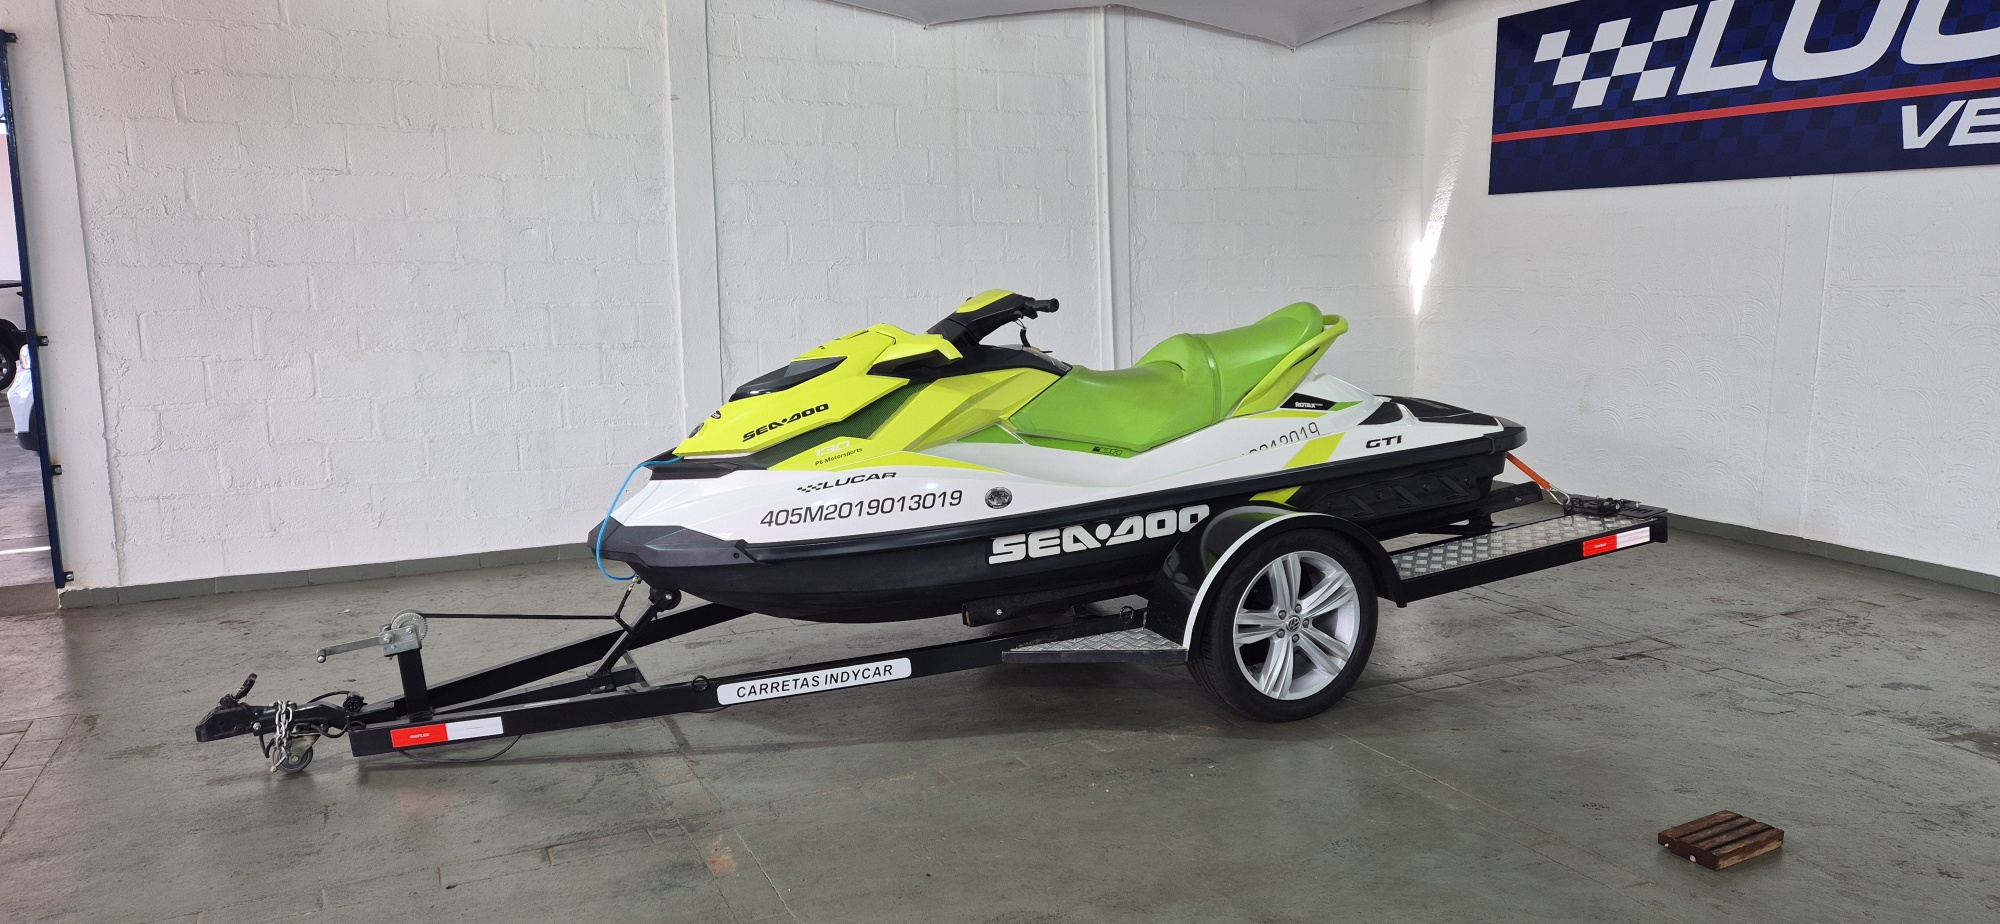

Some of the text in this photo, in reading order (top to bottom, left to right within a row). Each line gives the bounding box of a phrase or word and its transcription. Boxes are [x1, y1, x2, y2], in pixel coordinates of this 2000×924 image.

[1295, 401, 1316, 409] ROTAX
[814, 440, 851, 457] 130
[1366, 435, 1403, 449] GTI
[824, 447, 863, 464] Motorsports
[822, 472, 897, 489] LUCAR
[760, 489, 963, 527] 405M2019013019
[736, 664, 893, 698] CARRETAS INDYCAR
